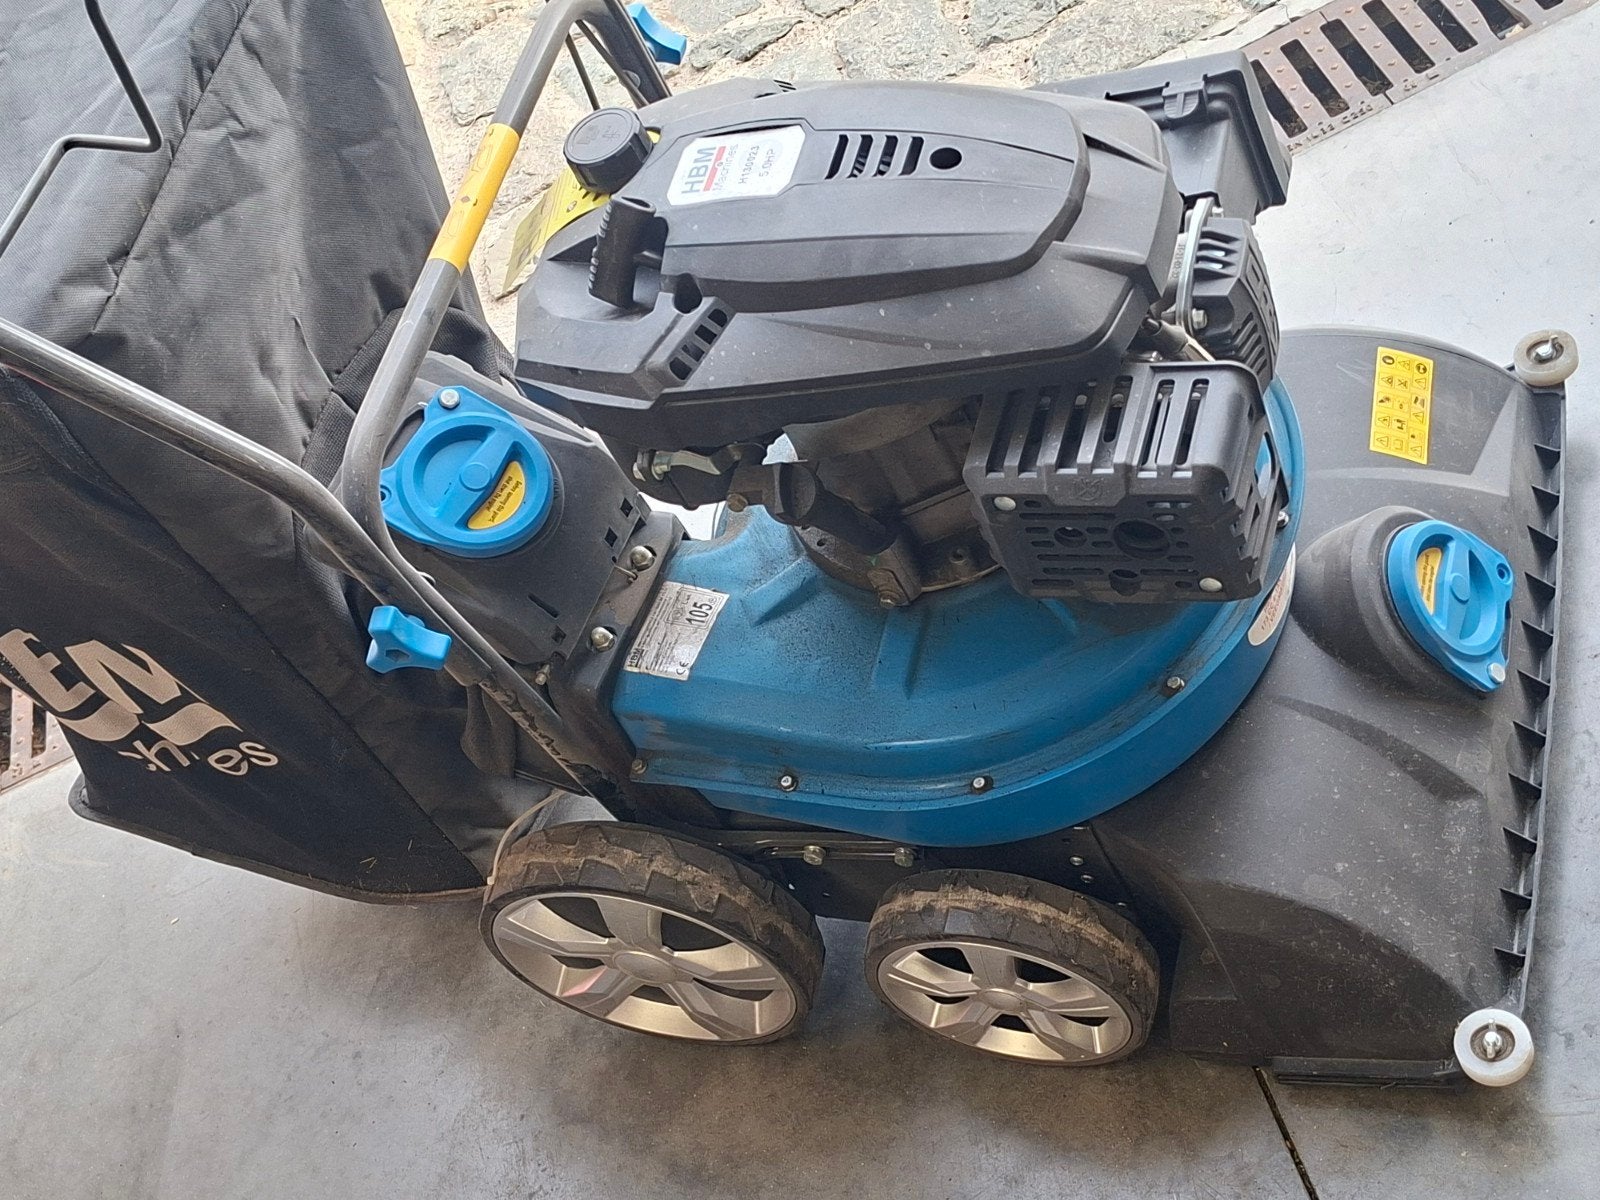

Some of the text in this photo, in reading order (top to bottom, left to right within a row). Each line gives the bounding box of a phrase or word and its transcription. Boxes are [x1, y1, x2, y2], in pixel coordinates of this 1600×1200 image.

[681, 146, 717, 194] HBM
[712, 143, 739, 191] Machines
[685, 602, 713, 625] 105
